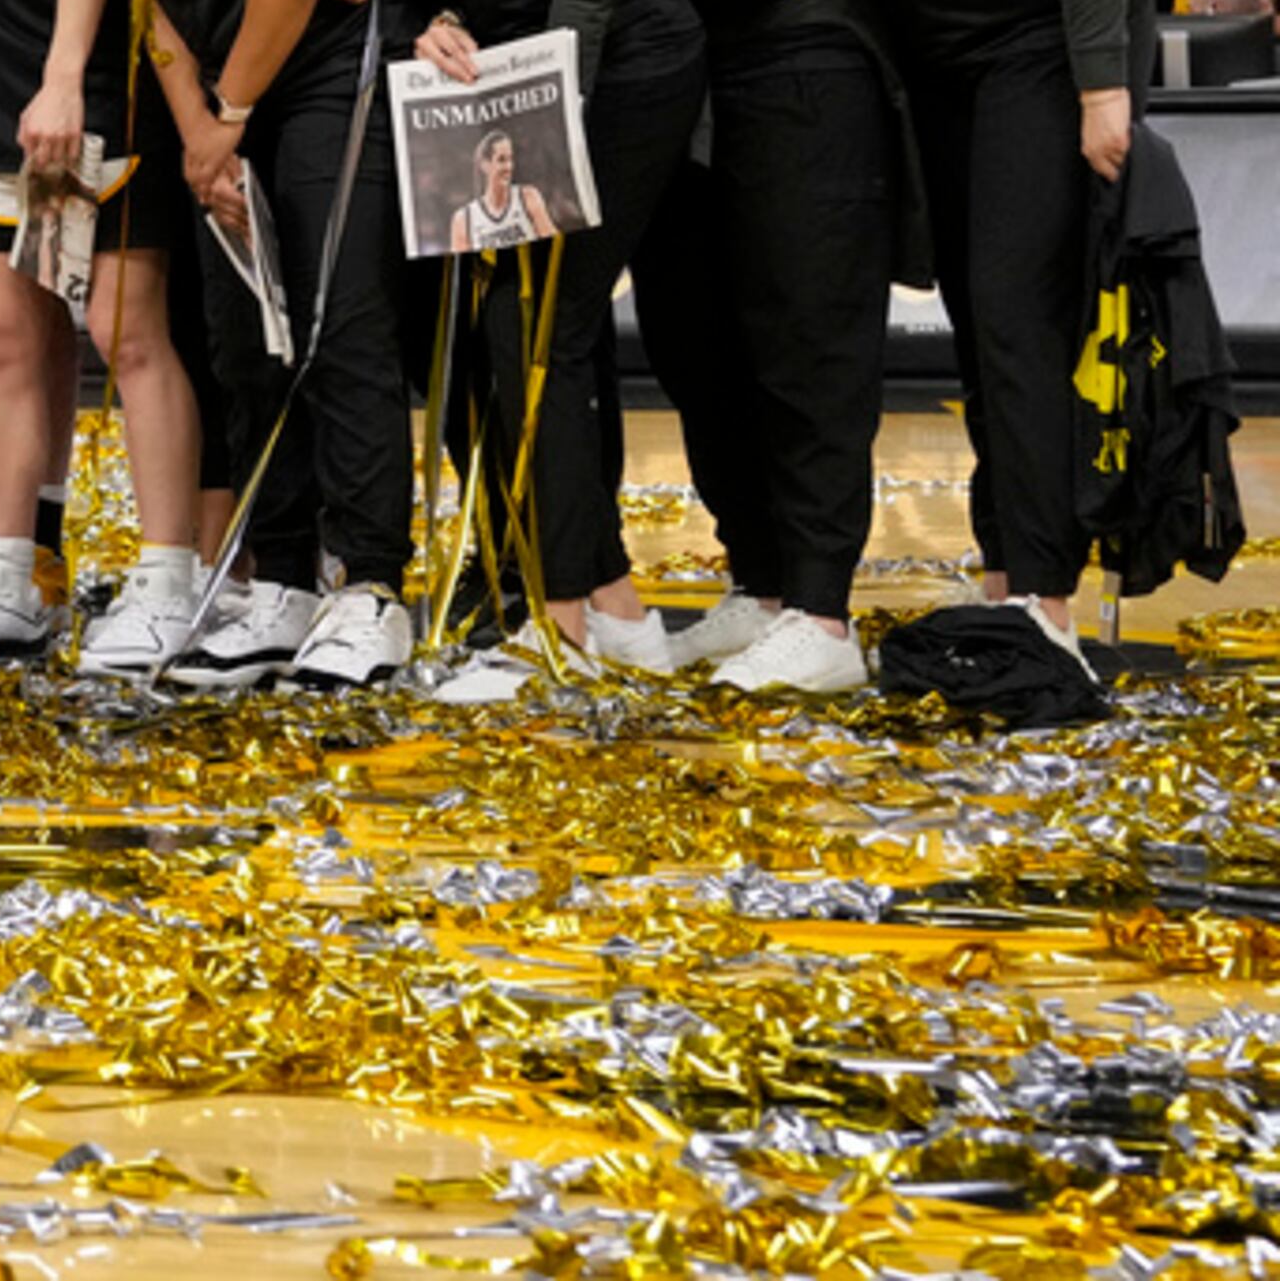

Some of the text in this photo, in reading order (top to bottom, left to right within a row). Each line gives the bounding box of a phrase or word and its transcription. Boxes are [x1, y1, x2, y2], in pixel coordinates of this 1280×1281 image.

[406, 69, 435, 90] The
[510, 47, 557, 74] Register
[411, 82, 559, 131] UNMATCHED
